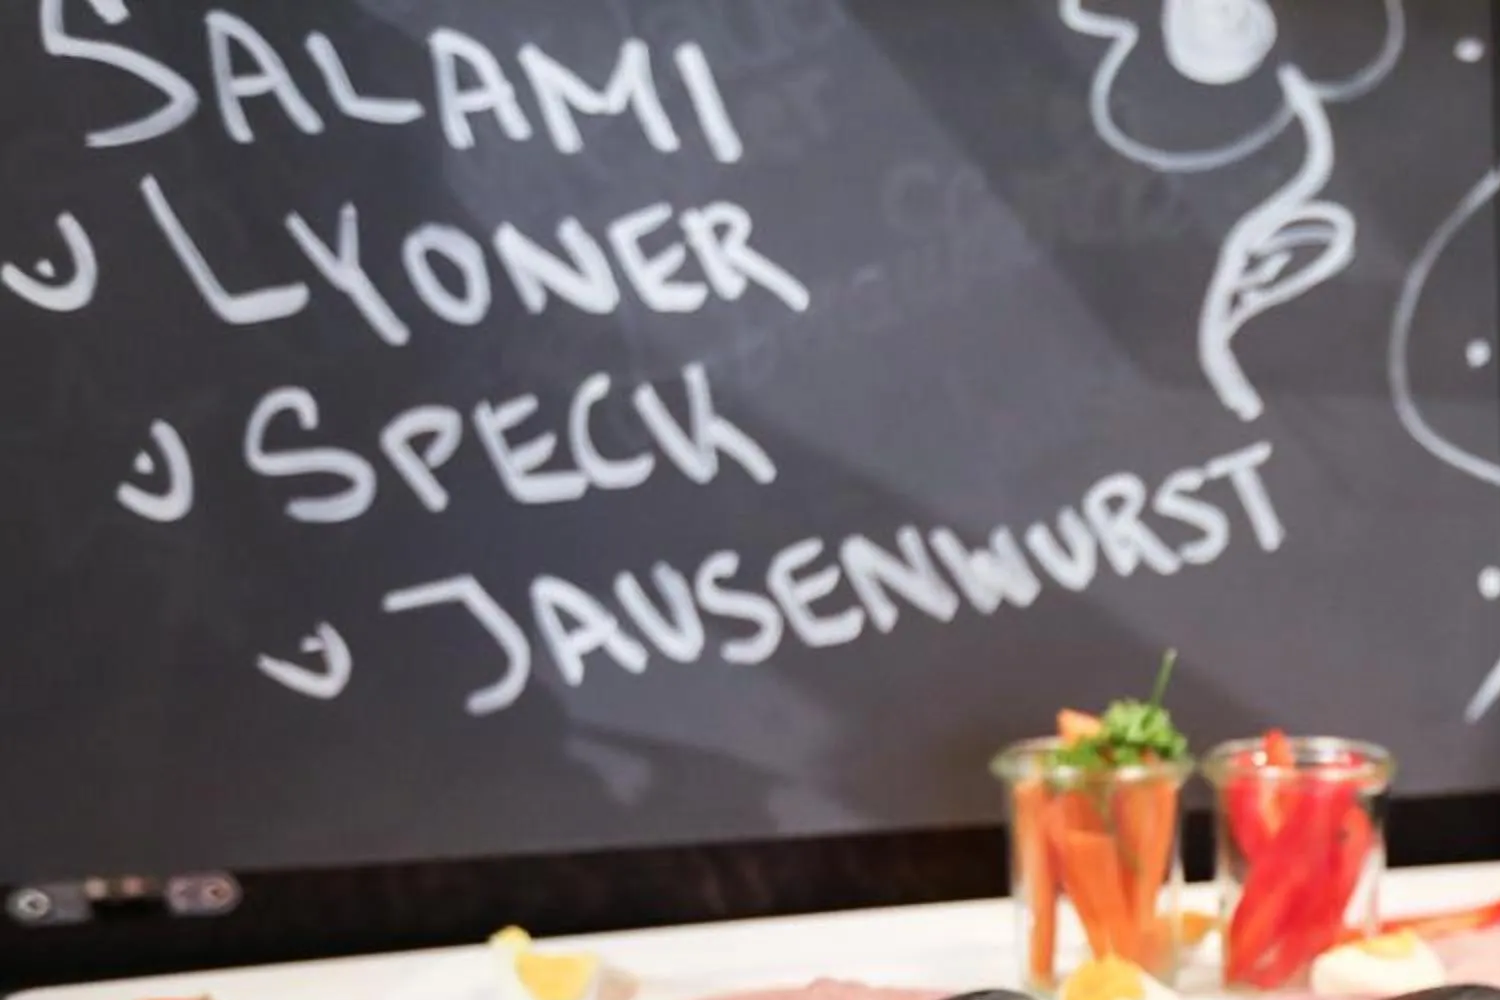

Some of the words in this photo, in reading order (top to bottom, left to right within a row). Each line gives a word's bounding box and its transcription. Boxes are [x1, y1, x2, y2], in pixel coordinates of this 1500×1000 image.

[41, 0, 744, 164] SALAMI
[142, 175, 811, 346] LYONER
[246, 361, 777, 522] SPECK
[383, 441, 1286, 713] JAUSENWURST
